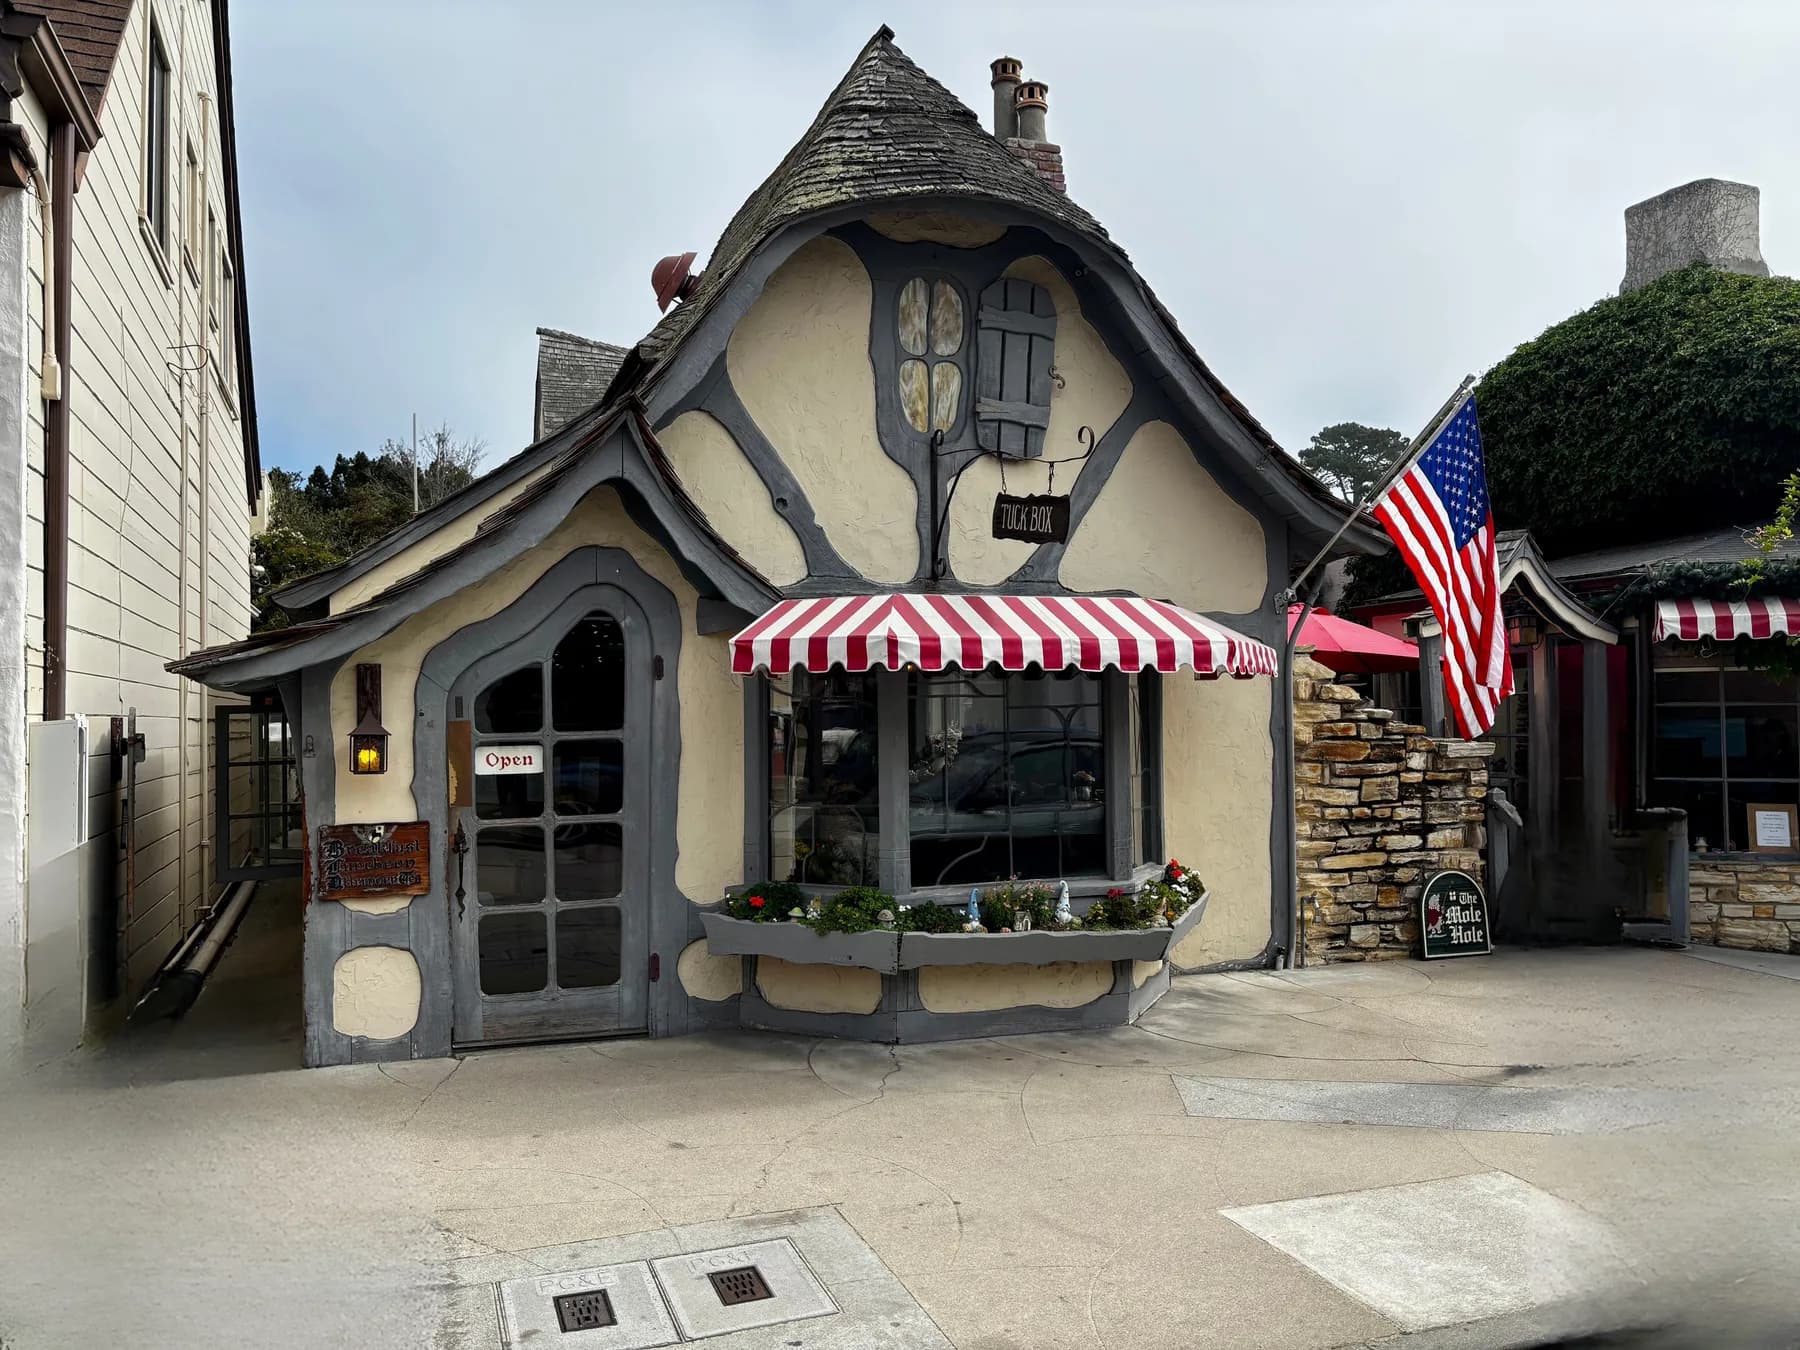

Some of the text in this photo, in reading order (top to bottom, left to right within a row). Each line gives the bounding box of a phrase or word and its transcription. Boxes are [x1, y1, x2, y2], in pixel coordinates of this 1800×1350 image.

[1001, 503, 1053, 533] TUCK BOX
[485, 752, 533, 770] Open
[1458, 892, 1477, 904] The
[1445, 905, 1482, 924] Mole
[1449, 925, 1484, 944] Hole
[539, 1269, 614, 1293] PG&E
